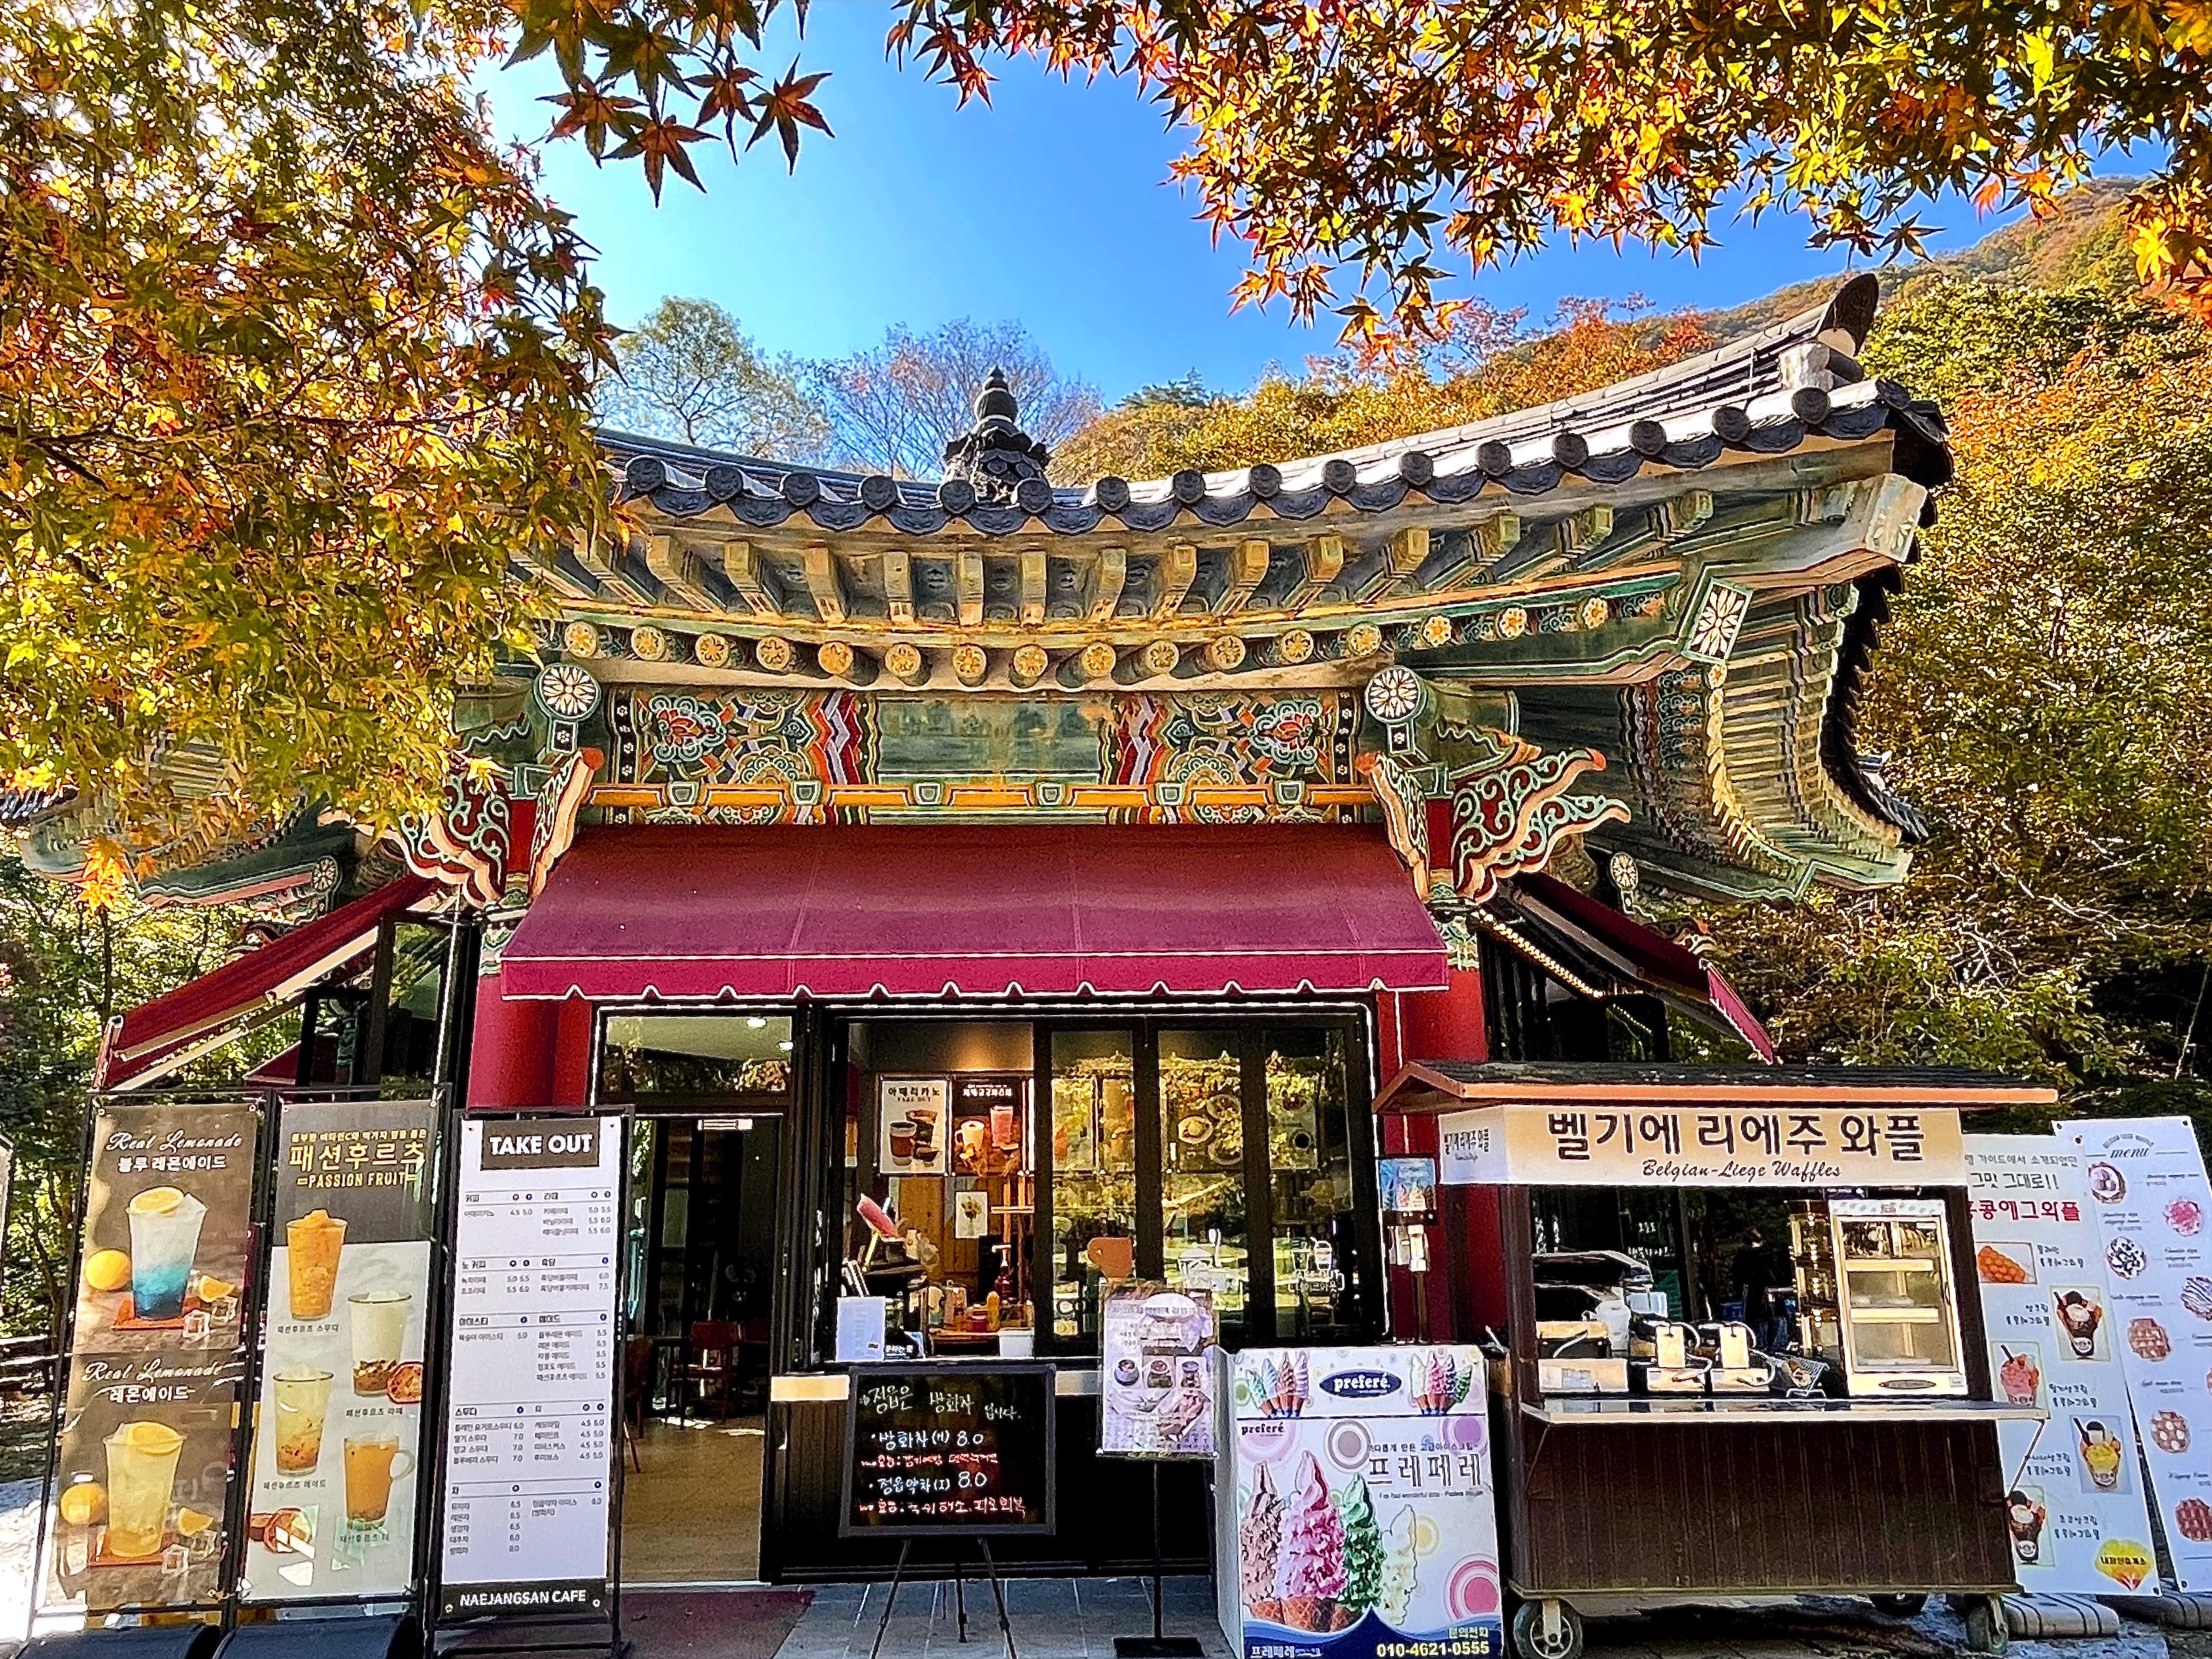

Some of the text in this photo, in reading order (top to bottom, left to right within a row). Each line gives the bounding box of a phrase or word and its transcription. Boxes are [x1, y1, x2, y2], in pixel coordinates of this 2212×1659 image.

[106, 1129, 242, 1153] Real Lemonade
[489, 1133, 593, 1156] TAKE OUT
[1548, 1113, 1924, 1161] 벨기에 리에주 와플
[289, 1141, 425, 1172] 패션후르츠
[1978, 1154, 2026, 1164] 가이드에서
[2031, 1155, 2077, 1167] 소개되었던
[2110, 1148, 2150, 1158] menu
[118, 1154, 226, 1173] 블루 레몬에이드
[1642, 1159, 1840, 1182] Belgian-Liege Waffles
[308, 1171, 406, 1188] PASSION FRUIT
[1970, 1172, 2059, 1189] 그맛 그대로!!
[459, 1317, 488, 1325] 아이스티
[82, 1358, 223, 1383] Real Lemonade
[1333, 1372, 1388, 1392] preferé
[109, 1385, 189, 1403] 레몬에이드
[868, 1385, 913, 1414] 정읍은
[455, 1407, 478, 1416] 스무디
[1242, 1422, 1283, 1435] preferé
[957, 1430, 984, 1447] 8.0
[1367, 1453, 1481, 1487] 프레페레
[460, 1589, 586, 1607] NAEJANGSAN CAFE
[1377, 1641, 1490, 1657] 010-4621-0555
